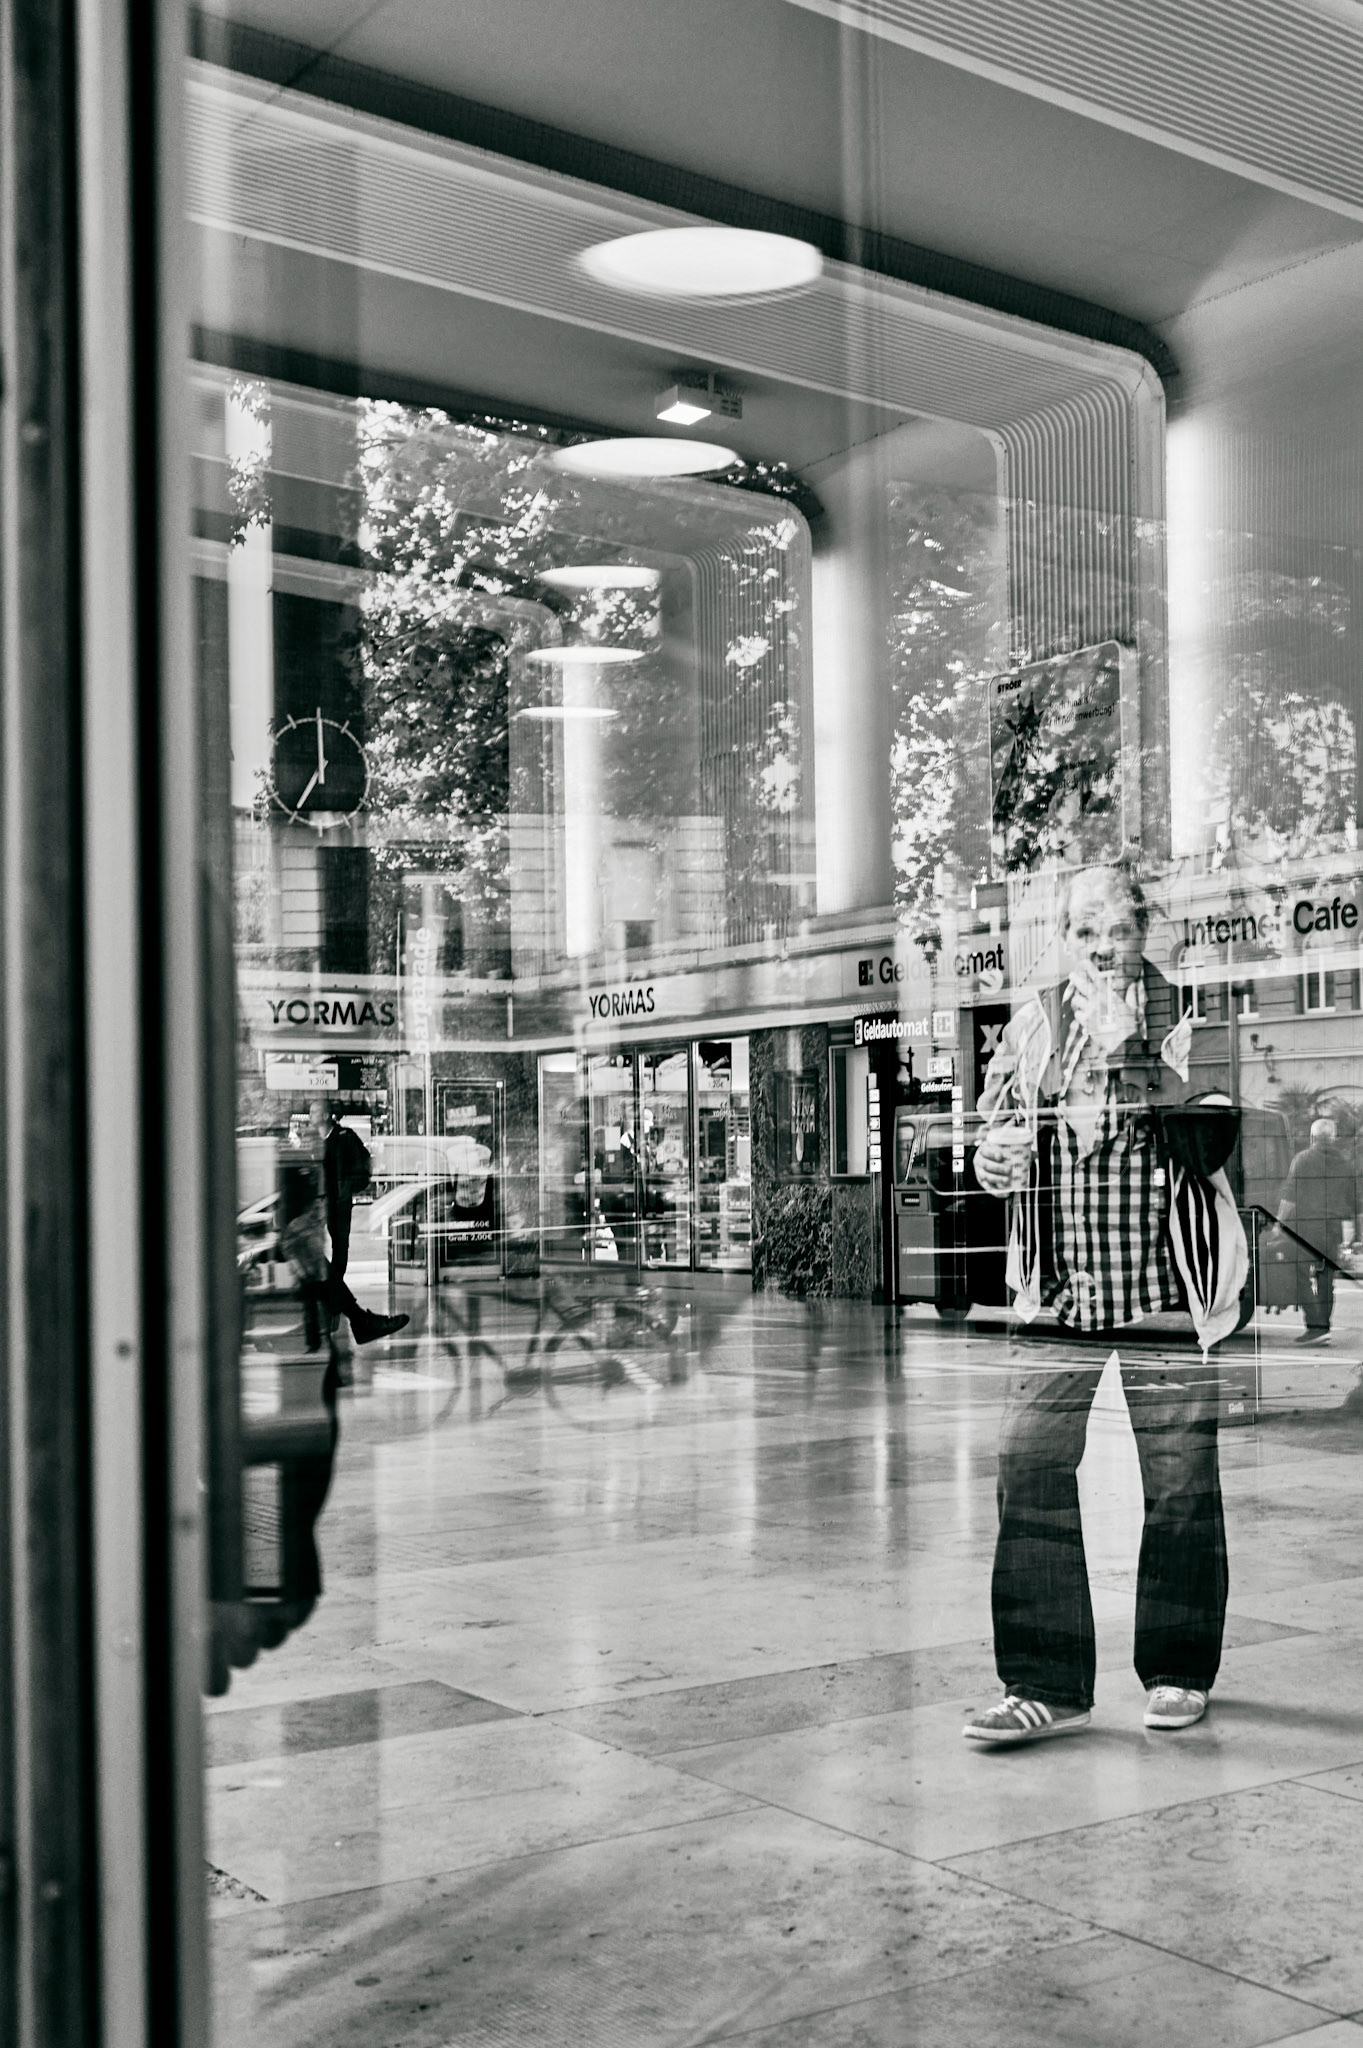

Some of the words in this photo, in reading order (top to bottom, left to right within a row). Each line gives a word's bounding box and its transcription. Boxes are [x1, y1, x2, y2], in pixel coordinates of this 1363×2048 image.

[267, 999, 395, 1026] YORMAS
[589, 986, 655, 1019] YORMAS
[863, 1017, 929, 1041] Geldautomat
